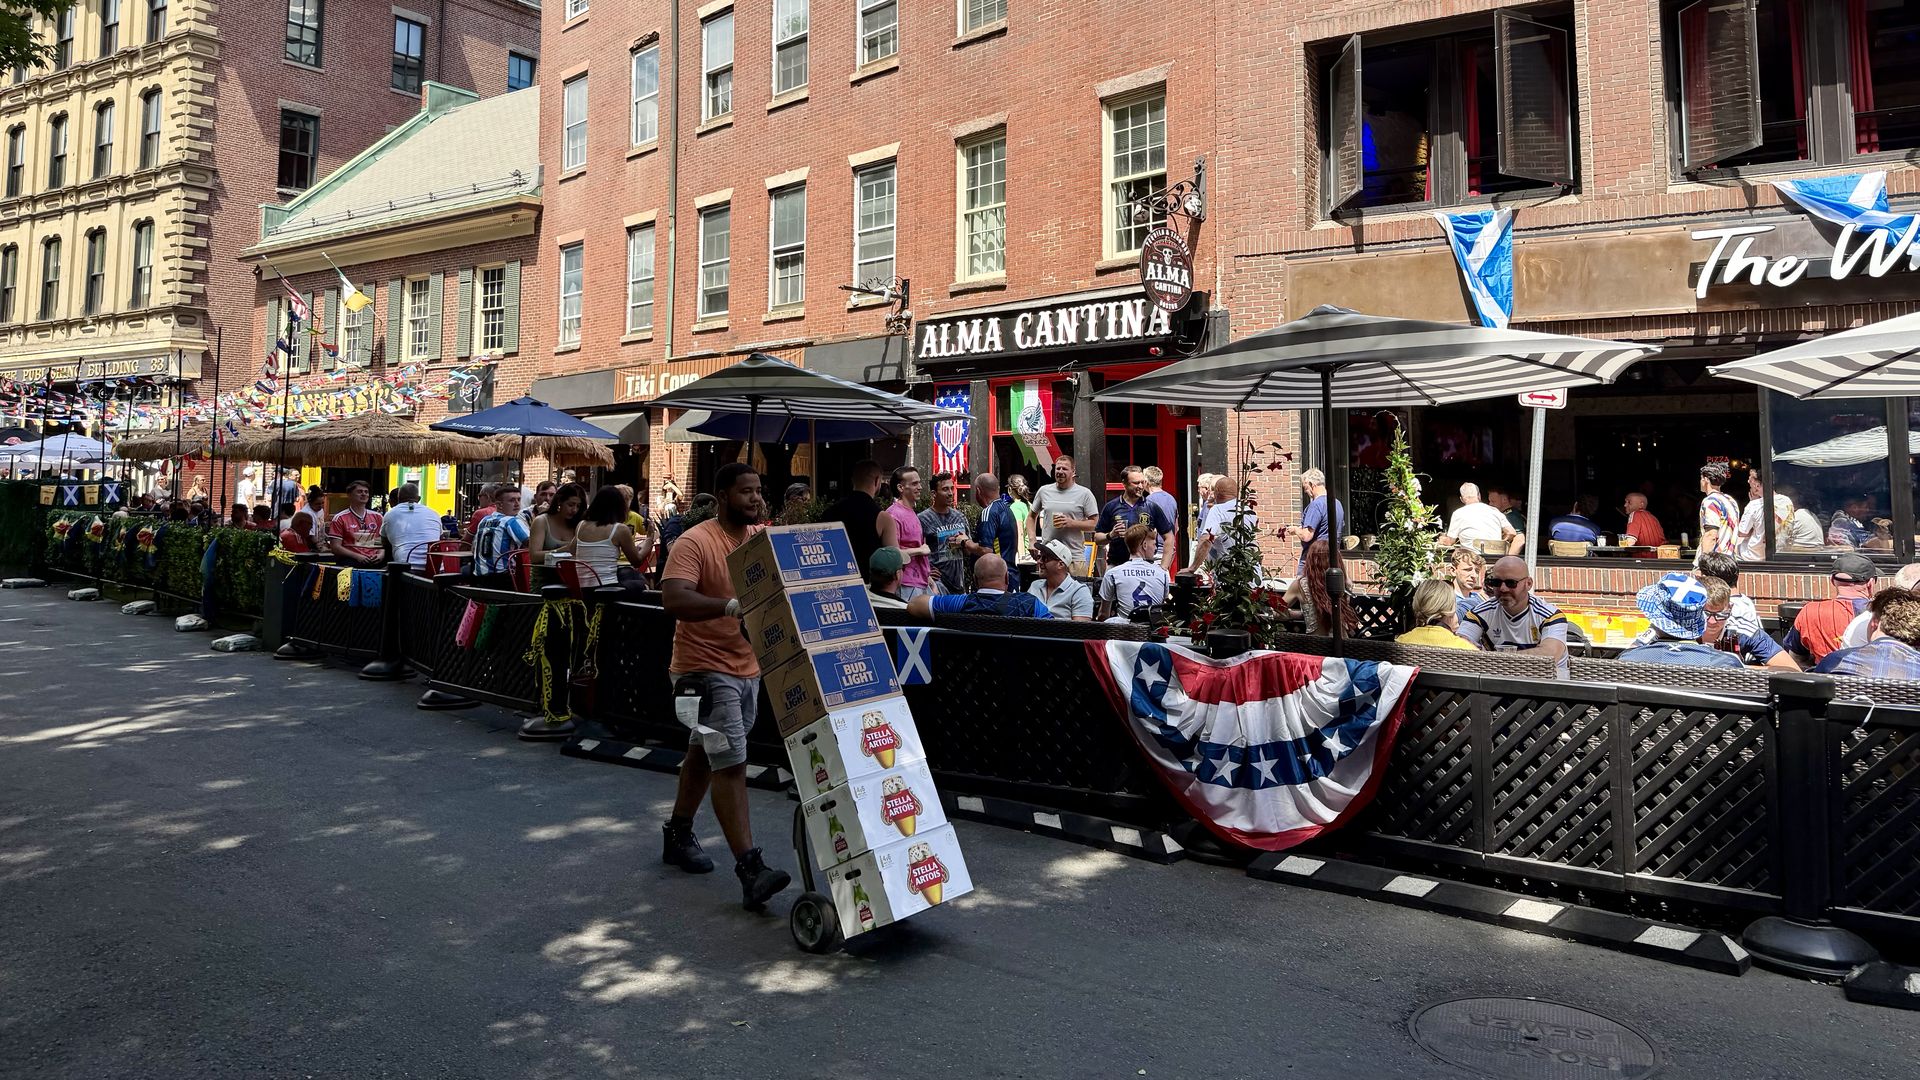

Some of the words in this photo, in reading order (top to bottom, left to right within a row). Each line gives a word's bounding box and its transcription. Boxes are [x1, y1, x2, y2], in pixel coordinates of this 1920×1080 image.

[1691, 225, 1809, 299] The
[1146, 261, 1191, 289] ALMA
[1154, 281, 1182, 295] CANTINA
[918, 316, 1005, 359] ALMA
[1013, 298, 1172, 350] CANTINA
[87, 359, 140, 377] BUILDING
[150, 358, 164, 372] 33
[626, 373, 655, 398] Tiki
[801, 544, 824, 556] BUD
[800, 553, 832, 566] LIGHT
[745, 562, 762, 578] BUD
[1122, 569, 1155, 577] TIERNEY
[745, 571, 766, 588] LIGHT
[821, 602, 845, 614] BUD
[819, 611, 852, 625] LIGHT
[764, 623, 780, 640] BUD
[764, 632, 785, 649] LIGHT
[843, 661, 866, 675] BUD
[842, 672, 874, 687] LIGHT
[785, 685, 802, 699] BUD
[785, 692, 807, 710] LIGHT
[866, 729, 891, 741] STELLA
[868, 737, 894, 749] ARTOIS
[885, 796, 911, 809] STELLA
[889, 803, 914, 817] ARTOIS
[912, 862, 938, 877] STELLA
[915, 870, 941, 886] ARTOIS
[1468, 1013, 1594, 1041] SEWER
